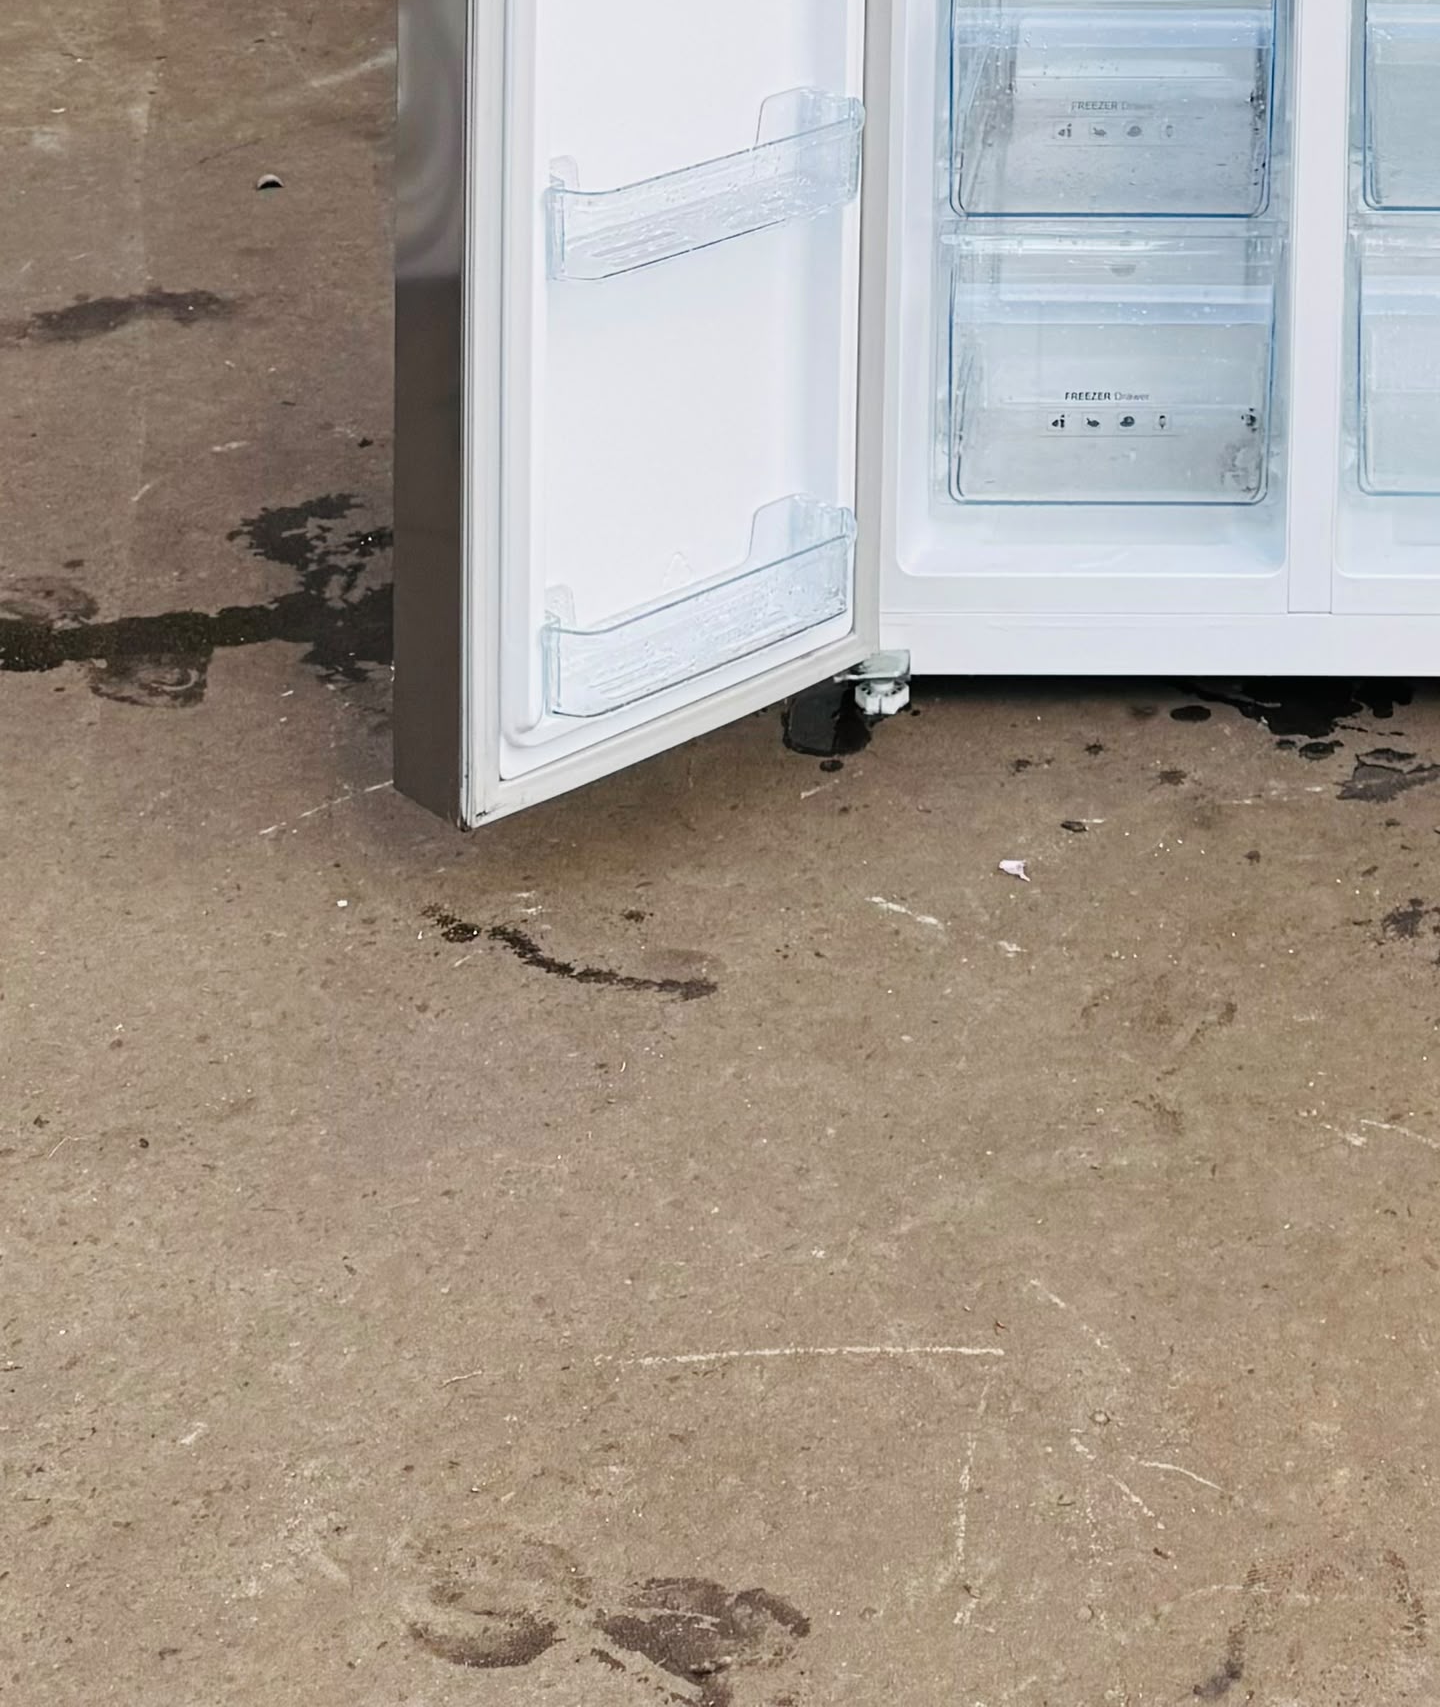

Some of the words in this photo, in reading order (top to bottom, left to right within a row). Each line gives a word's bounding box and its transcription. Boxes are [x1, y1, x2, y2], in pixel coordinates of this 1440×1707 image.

[1070, 100, 1118, 111] FREEZER
[1064, 391, 1111, 401] FREEZER
[1114, 391, 1150, 401] Drawer
